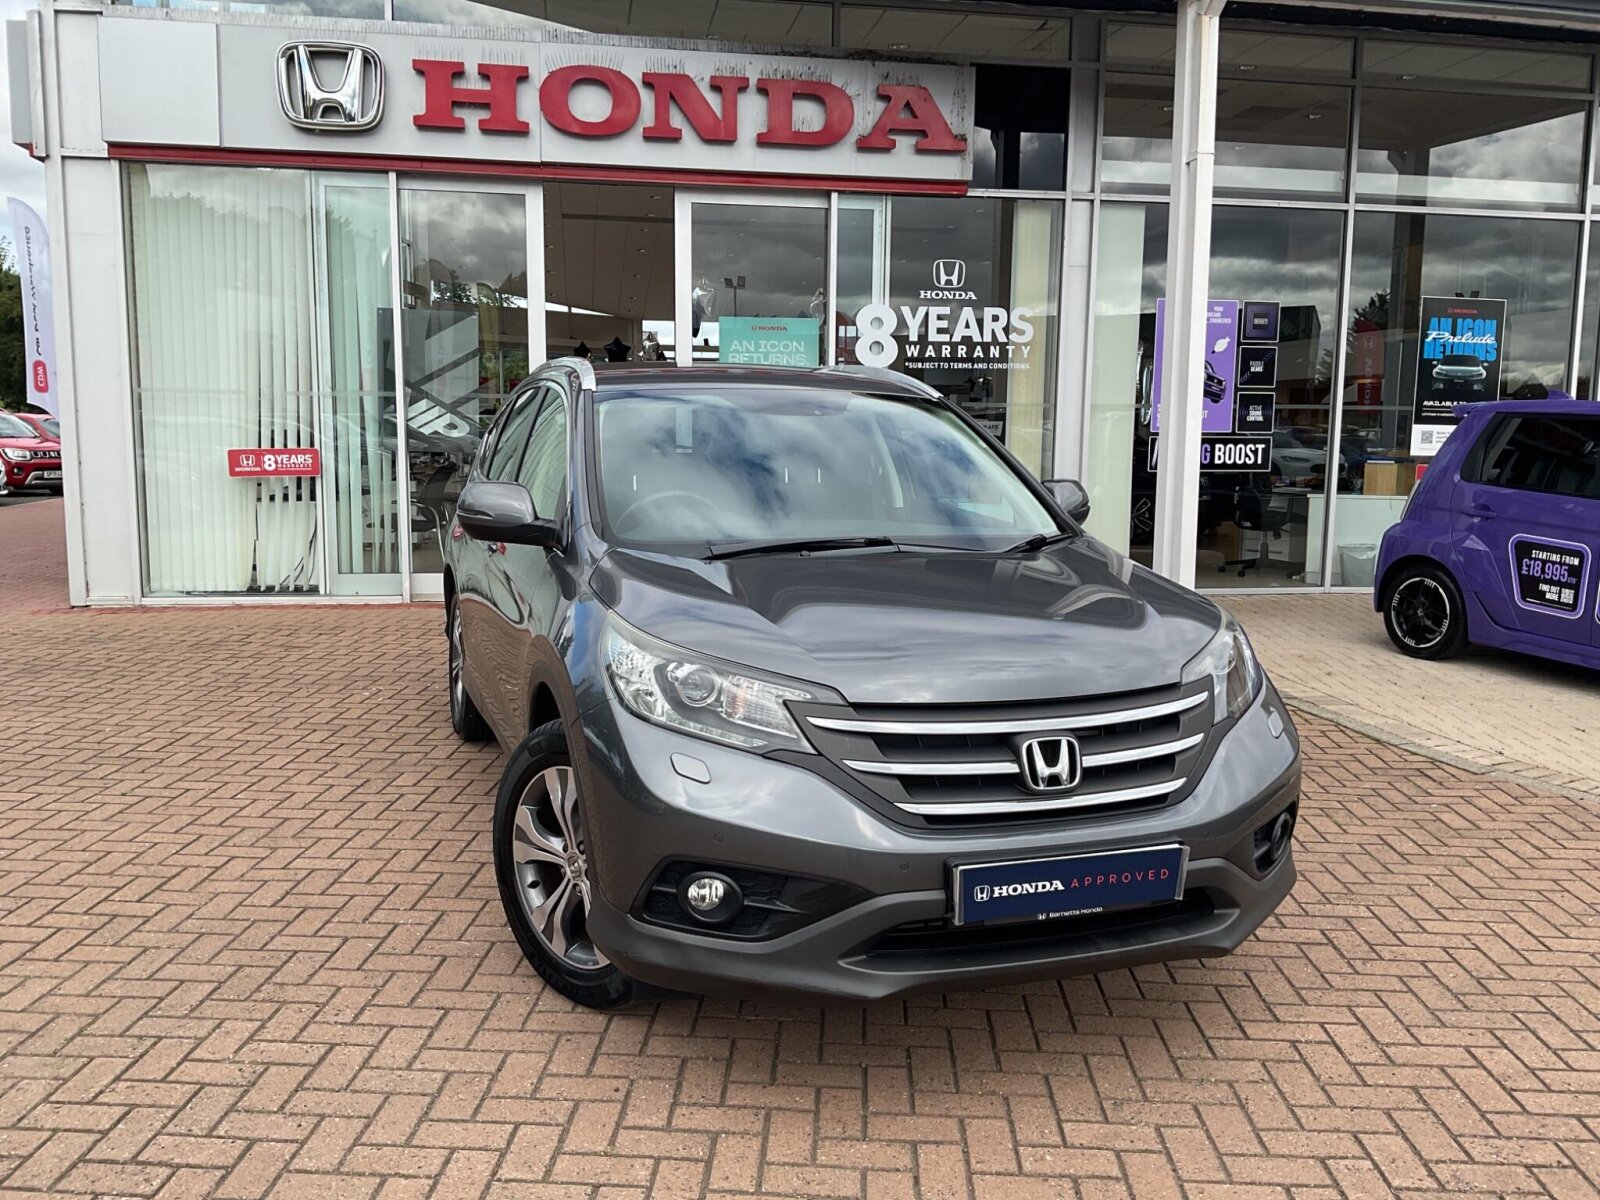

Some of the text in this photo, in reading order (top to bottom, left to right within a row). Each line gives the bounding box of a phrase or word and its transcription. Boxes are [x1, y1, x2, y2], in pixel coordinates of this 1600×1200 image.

[412, 59, 967, 152] HONDA
[919, 290, 978, 300] HONDA
[1429, 317, 1497, 338] AN ICON
[855, 303, 1034, 368] 8 YEARS
[1425, 331, 1496, 344] Prelude
[729, 340, 805, 353] AN ICON
[905, 344, 1032, 358] WARRANTY
[989, 362, 1030, 370] CONDITIONS
[1214, 443, 1266, 465] BOOST
[263, 454, 313, 471] 8 YEARS
[1531, 550, 1580, 566] STARTING FROM
[1521, 558, 1569, 582] £18,995
[1539, 583, 1560, 594] FIND OUT
[1545, 592, 1559, 601] MORE
[992, 868, 1170, 898] HONDA APPROVED
[1080, 906, 1103, 916] Honda
